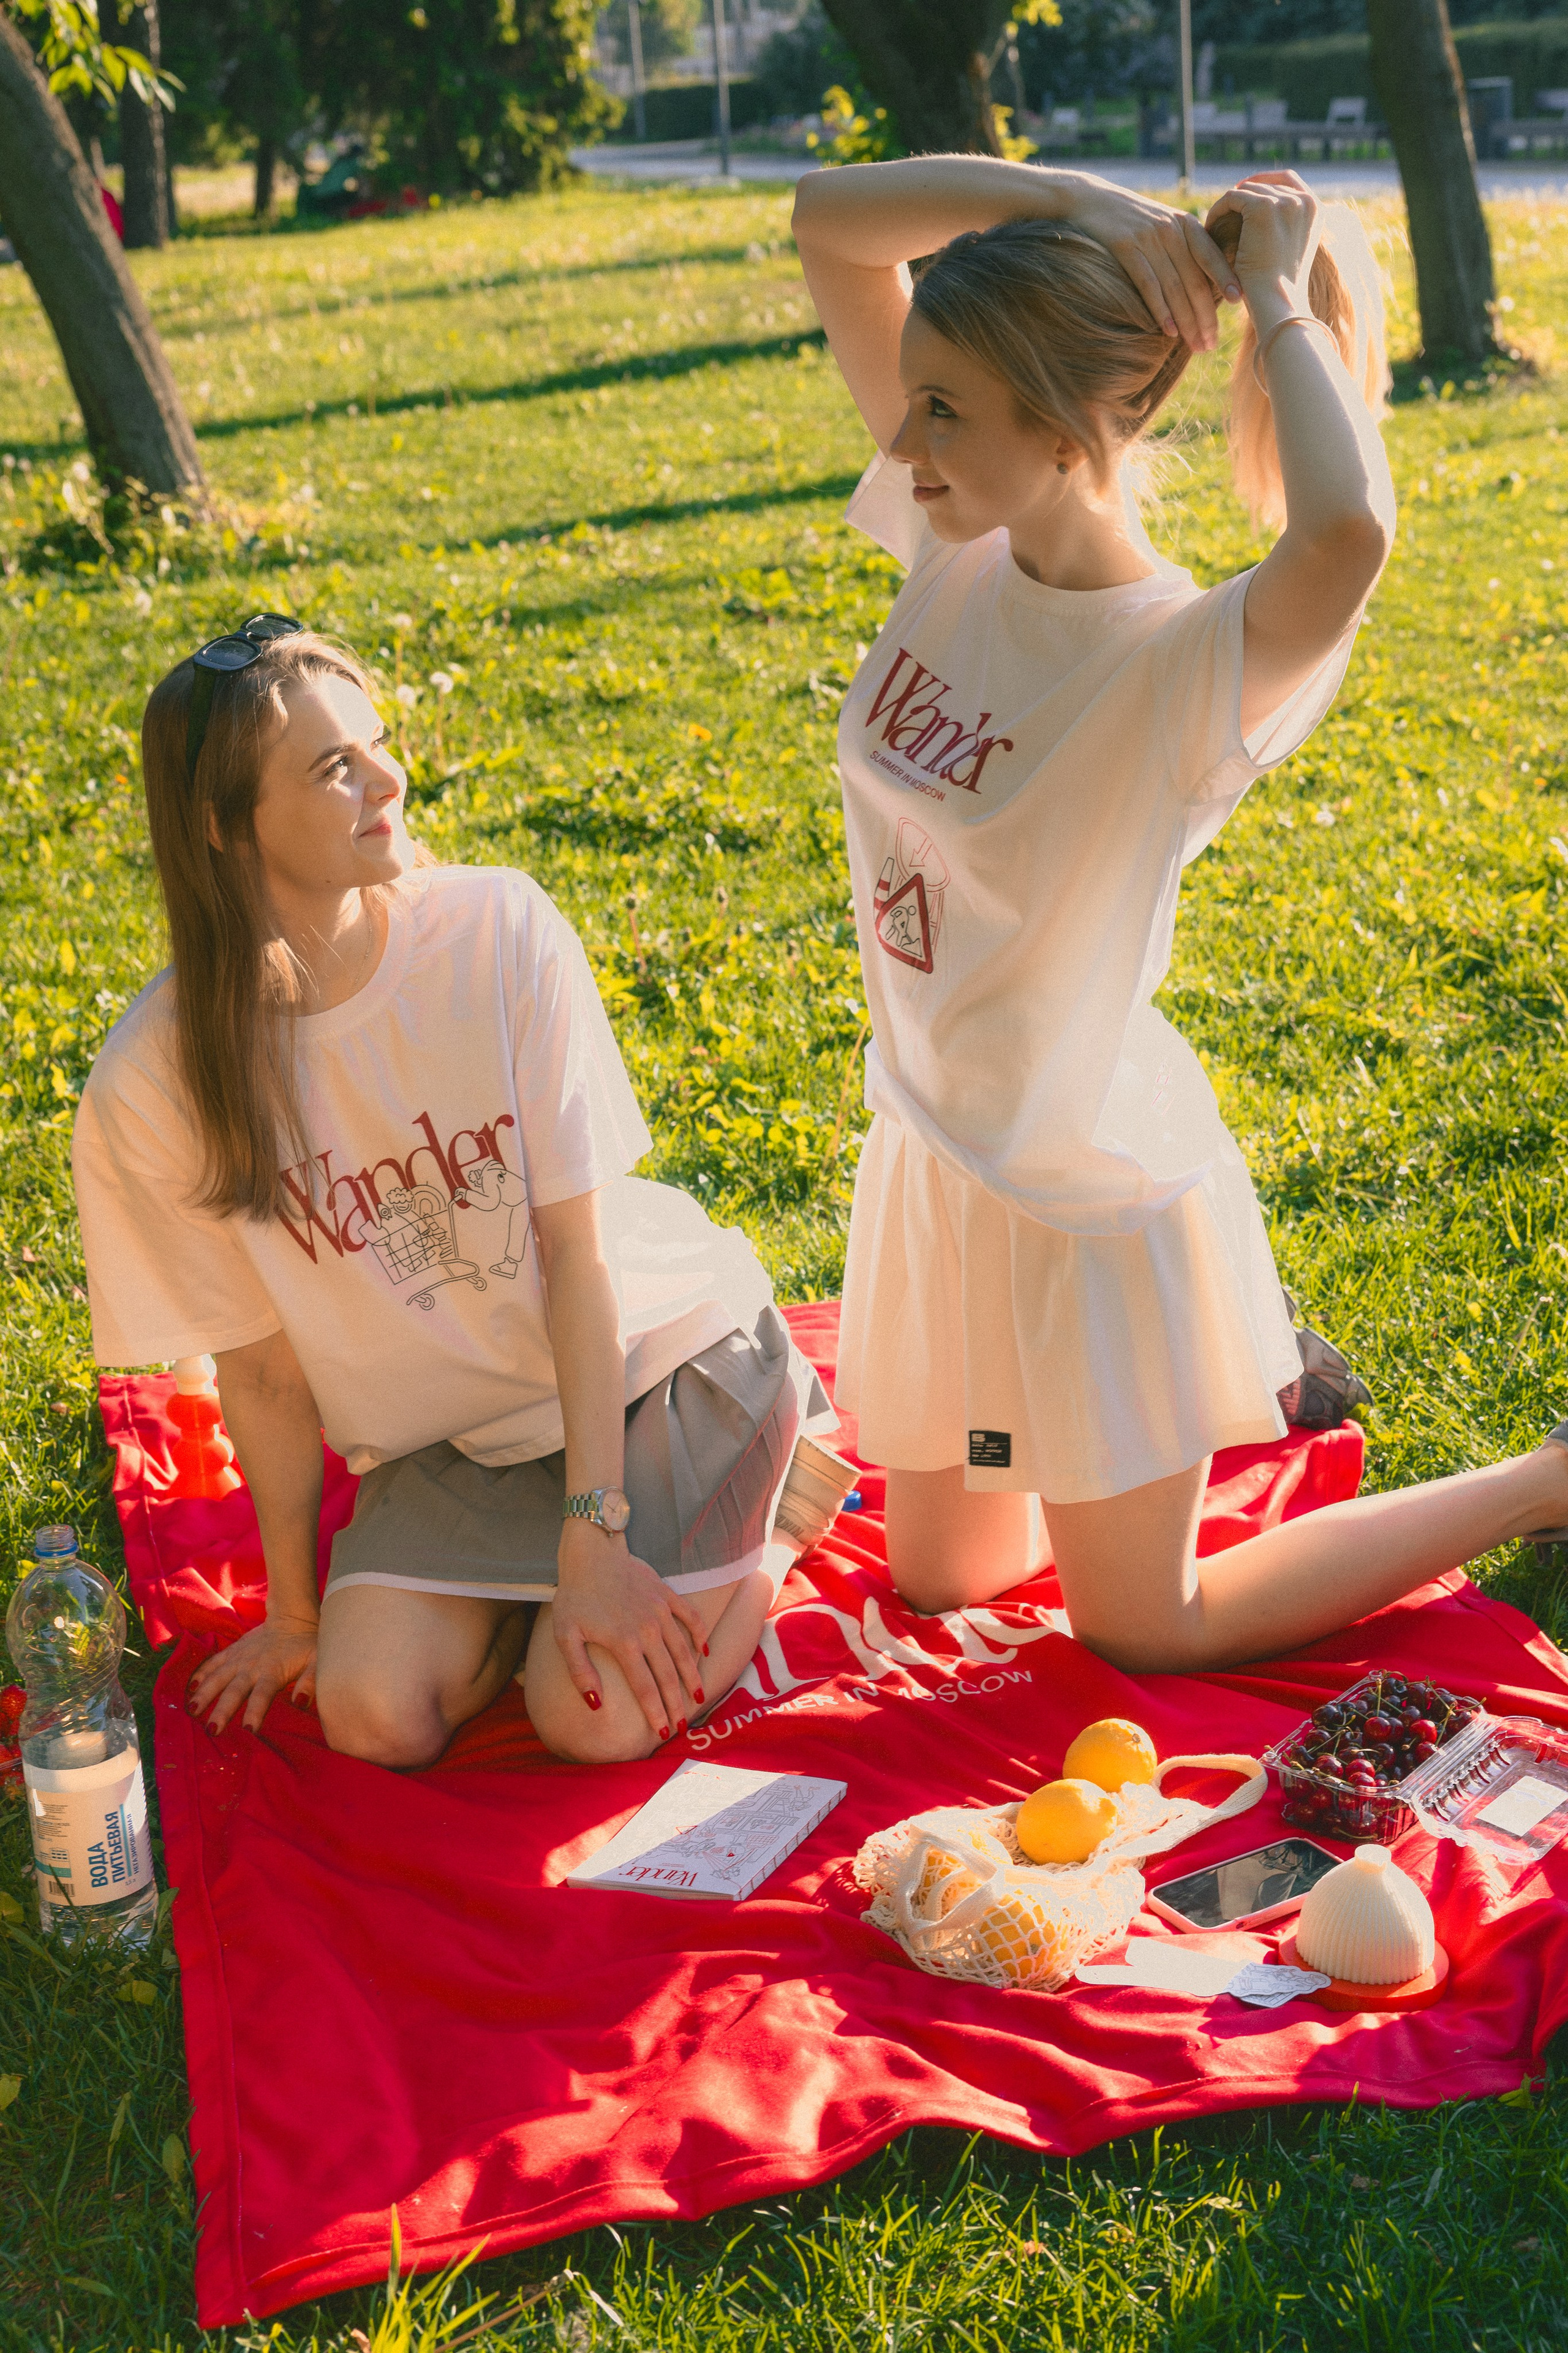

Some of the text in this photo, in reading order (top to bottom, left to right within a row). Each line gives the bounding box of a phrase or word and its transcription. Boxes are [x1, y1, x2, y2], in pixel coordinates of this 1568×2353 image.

[870, 750, 946, 802] SUMMER IN MOSCOW
[273, 1111, 514, 1264] Wander
[686, 1694, 839, 1751] SUMMER
[843, 1682, 880, 1703] IN
[87, 1841, 109, 1887] ВОДА
[105, 1810, 126, 1883] ПИТЬЕВАЯ
[618, 1866, 698, 1887] Wander
